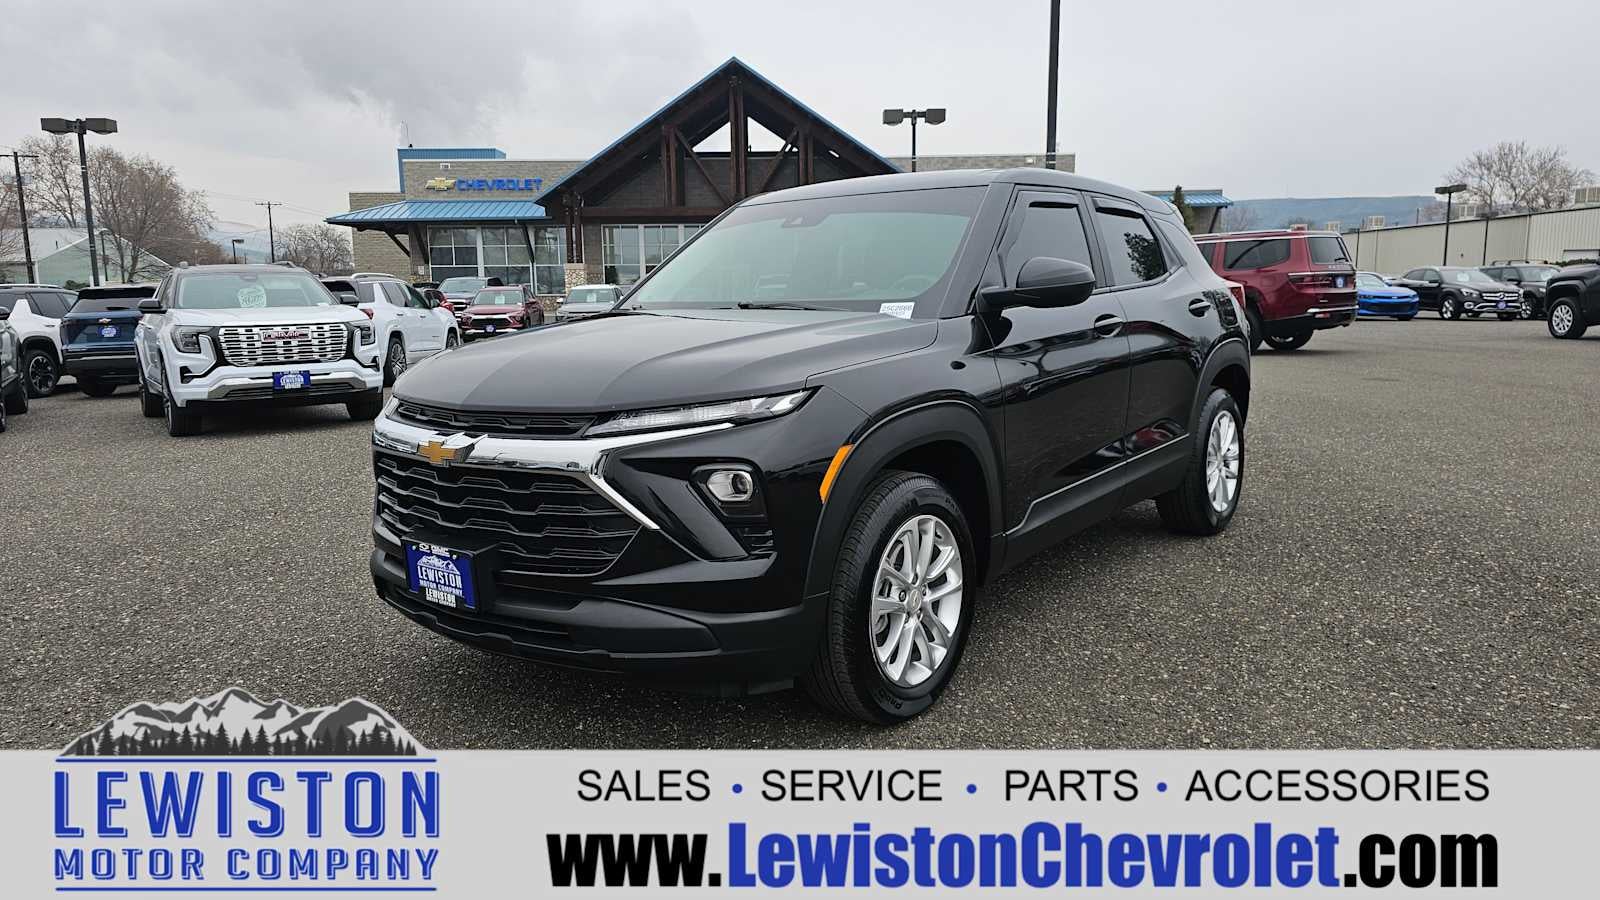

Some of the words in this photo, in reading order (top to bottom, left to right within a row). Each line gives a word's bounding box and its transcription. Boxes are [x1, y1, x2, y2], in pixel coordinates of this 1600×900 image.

[456, 177, 542, 191] CHEVROLET
[417, 566, 462, 589] LEWISTON
[425, 587, 456, 603] LEWISTON
